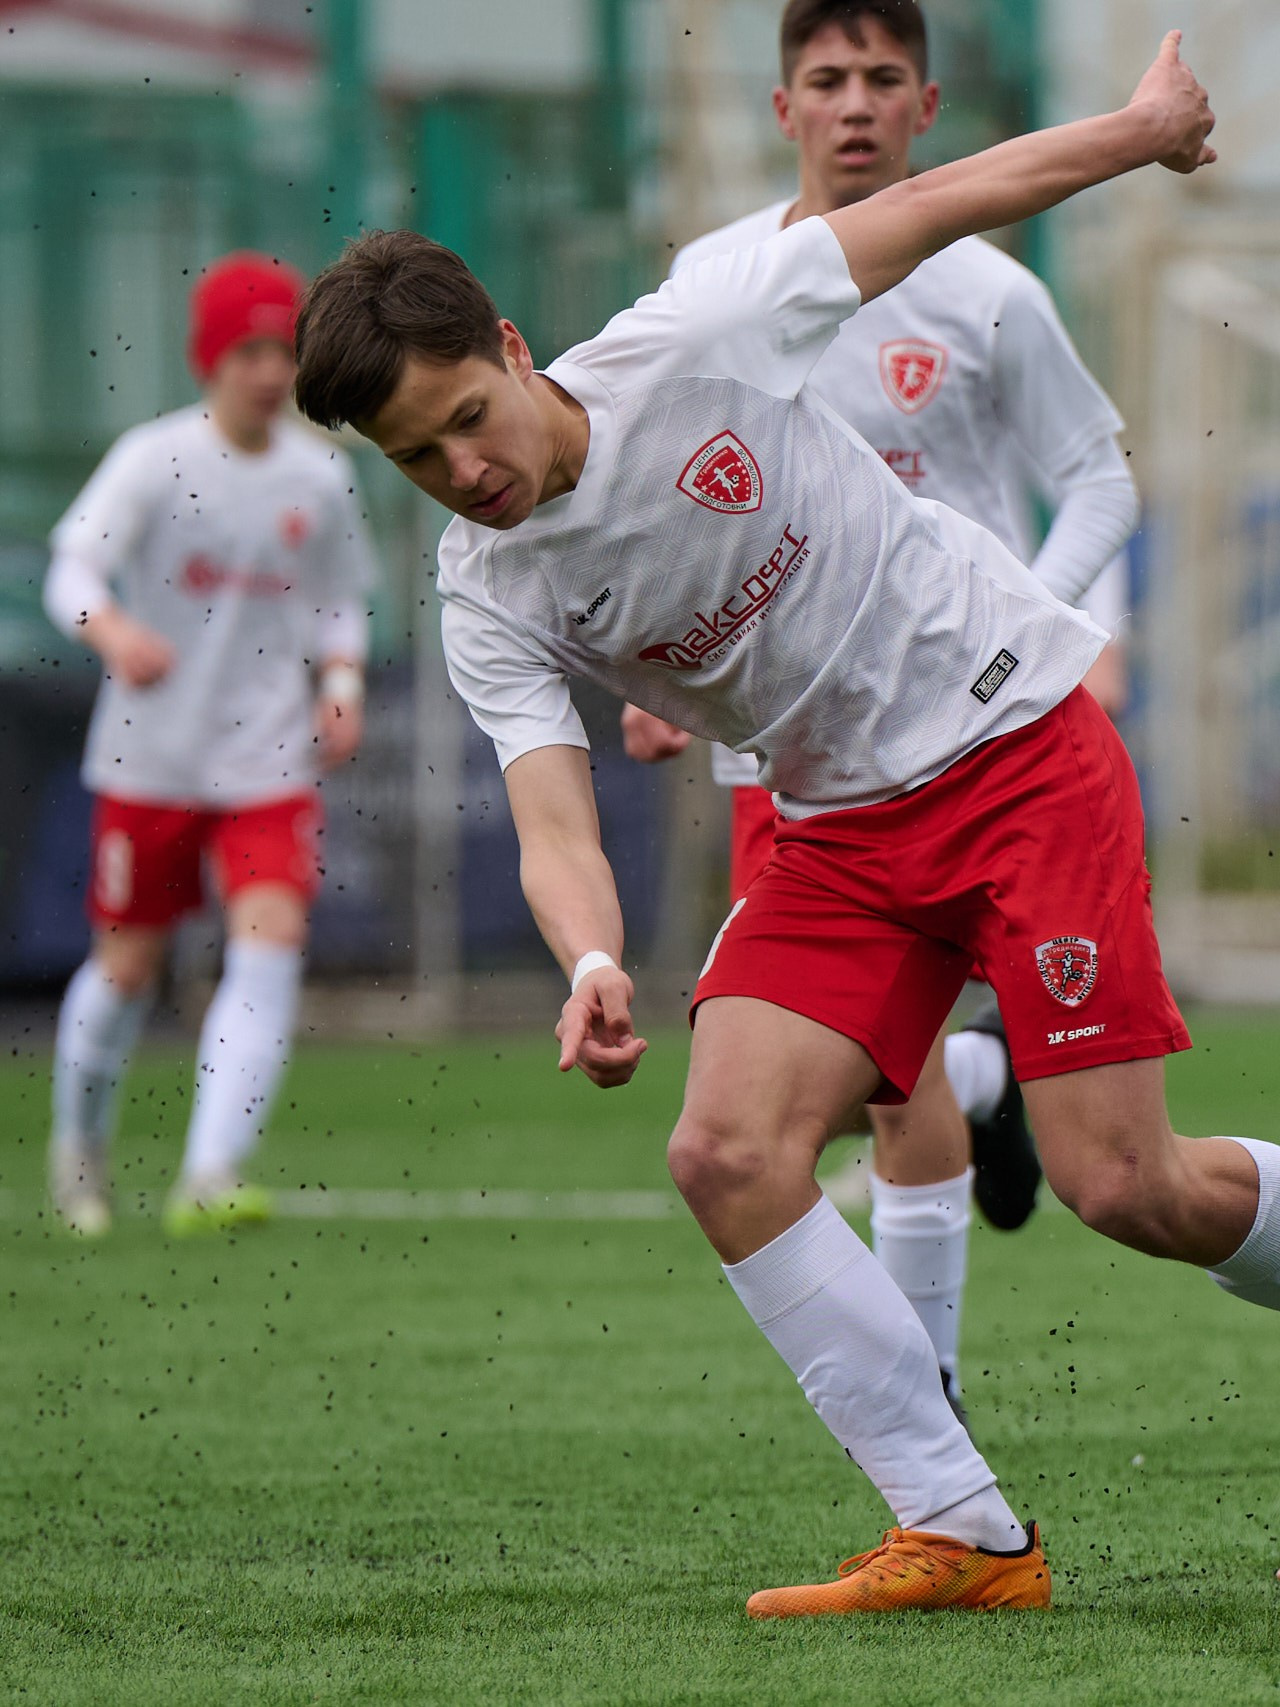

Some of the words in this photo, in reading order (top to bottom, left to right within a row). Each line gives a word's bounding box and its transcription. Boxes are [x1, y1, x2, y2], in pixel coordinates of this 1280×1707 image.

[692, 445, 715, 470] ЦЕНТР
[697, 492, 747, 510] ПОДГОТОВКИ
[587, 587, 612, 617] SPORT
[1047, 1030, 1066, 1045] 2K
[1067, 1023, 1106, 1041] SPORT
